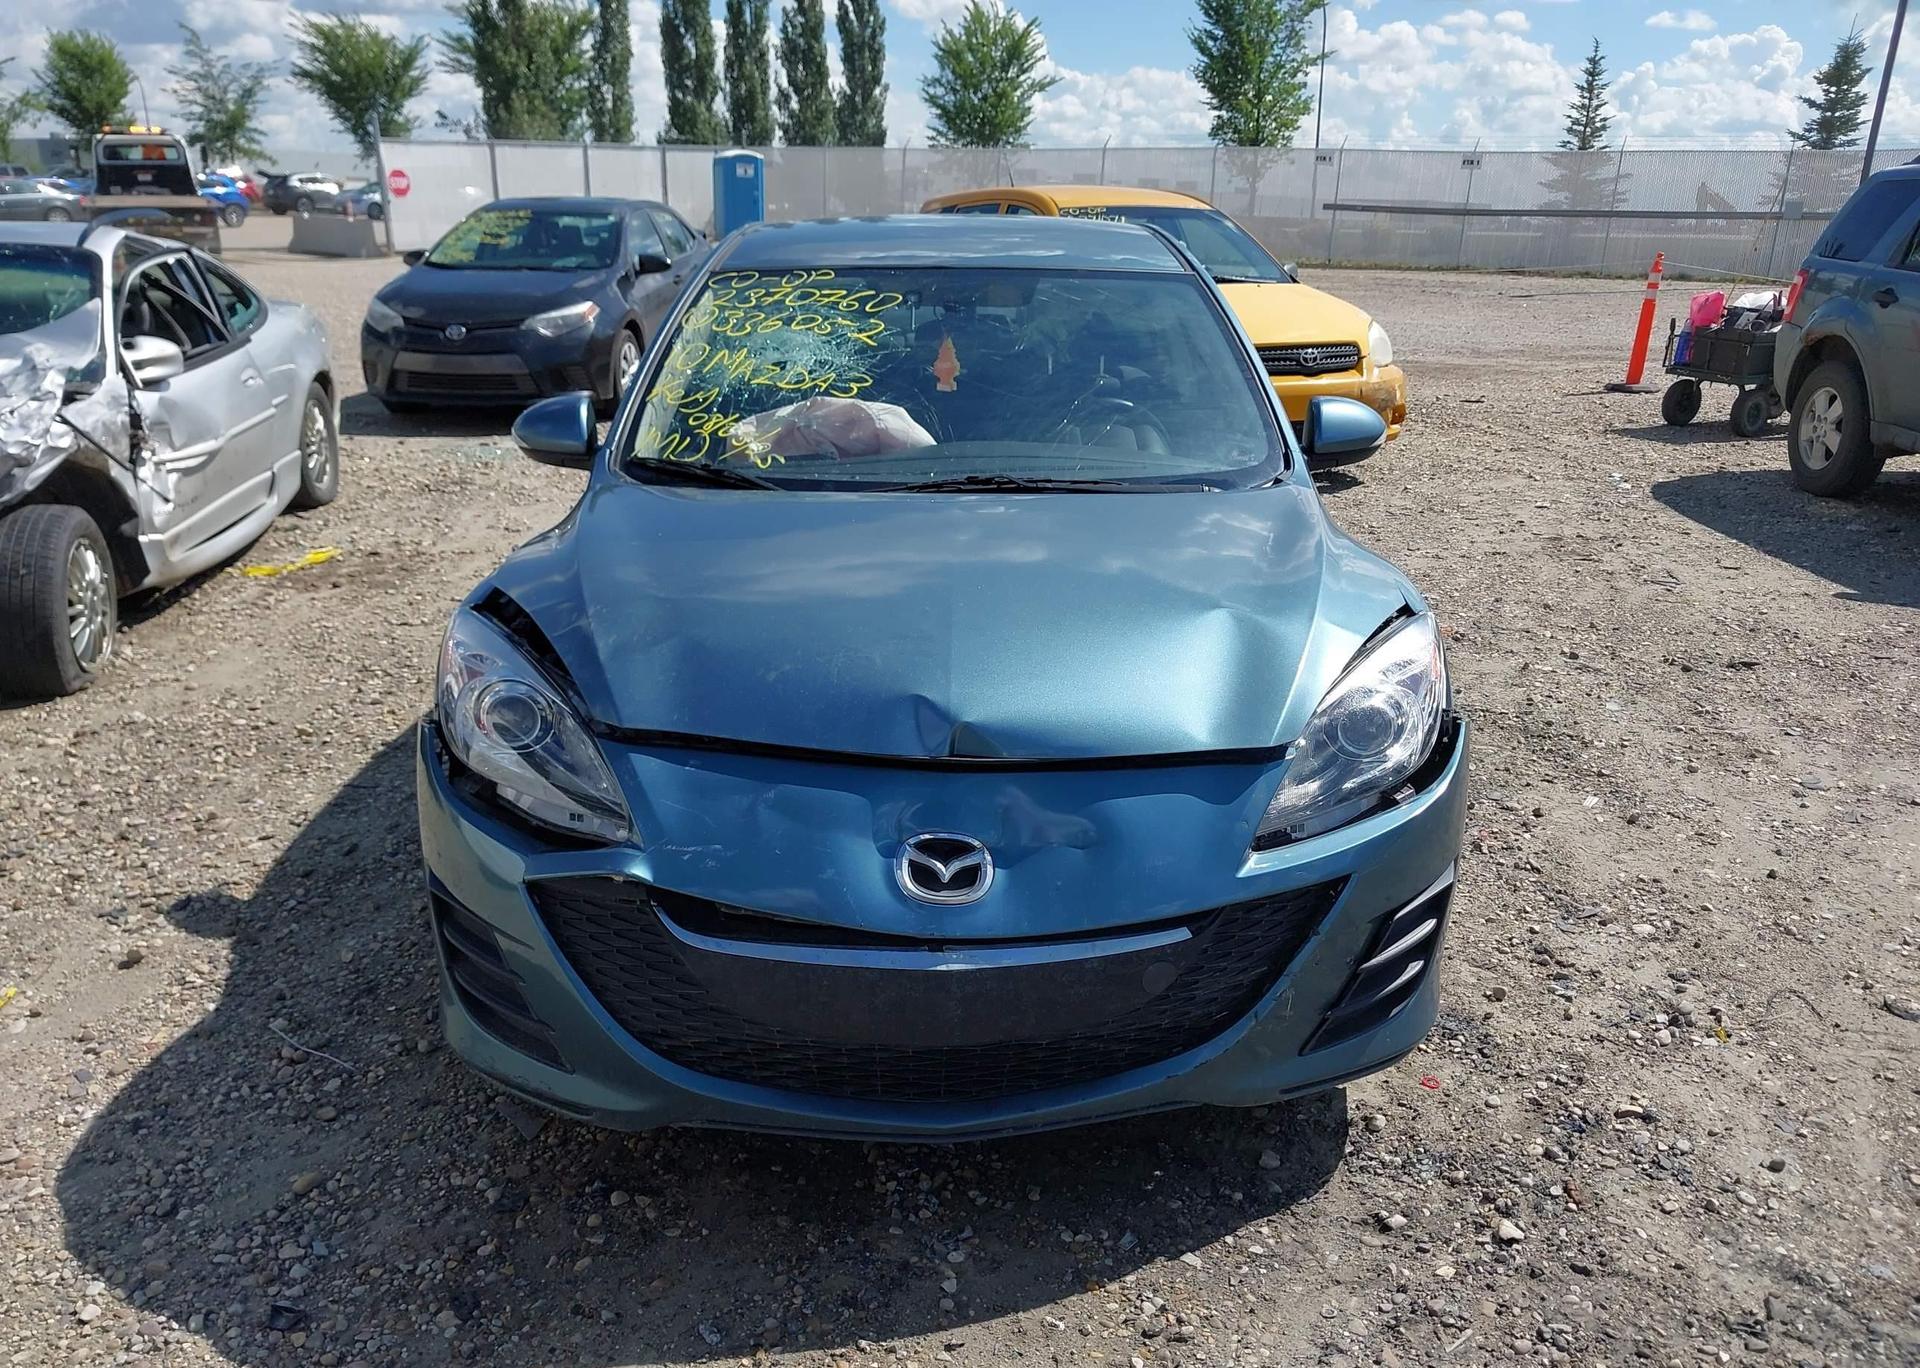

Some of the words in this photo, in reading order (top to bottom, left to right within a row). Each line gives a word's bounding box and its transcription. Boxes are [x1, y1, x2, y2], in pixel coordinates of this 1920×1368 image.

[390, 176, 408, 188] STOP
[708, 269, 836, 289] CO-OP
[711, 287, 903, 313] 2370760
